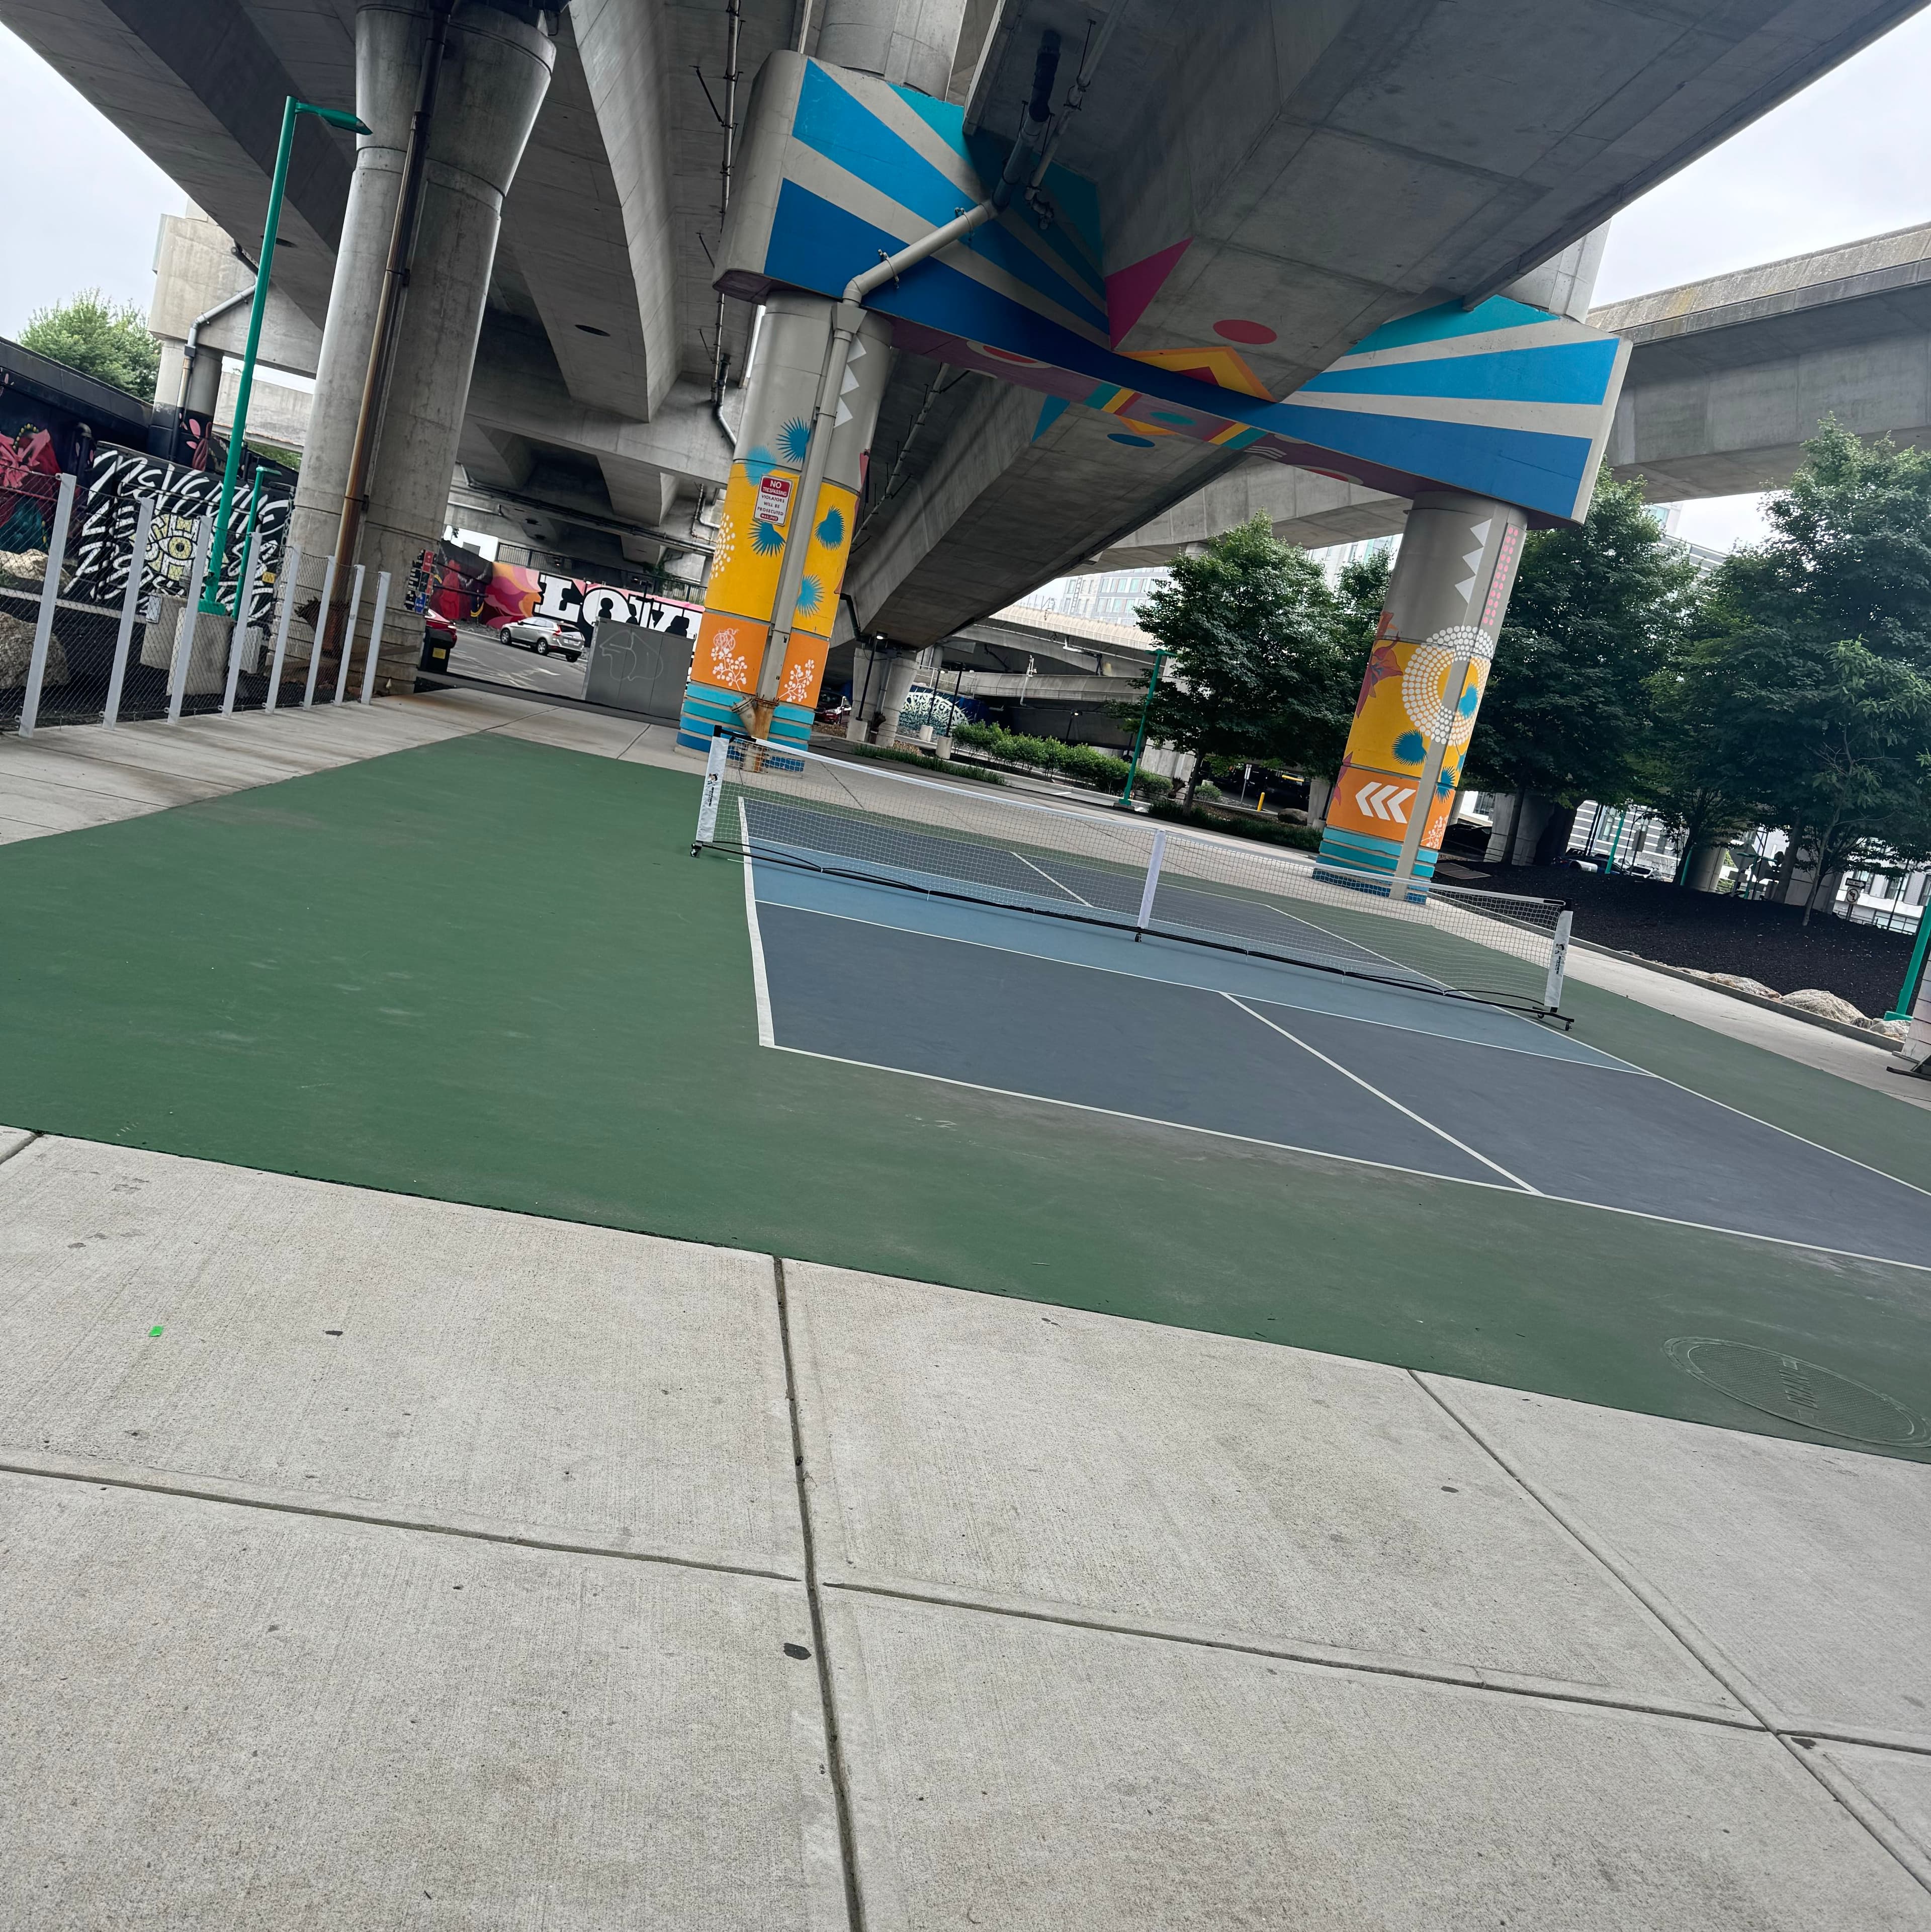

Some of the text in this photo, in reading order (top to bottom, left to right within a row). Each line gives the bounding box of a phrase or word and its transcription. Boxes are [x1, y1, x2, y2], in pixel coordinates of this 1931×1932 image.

[770, 480, 781, 488] NO
[762, 494, 784, 503] VIOLATORS
[757, 507, 783, 516] PROSECUTED
